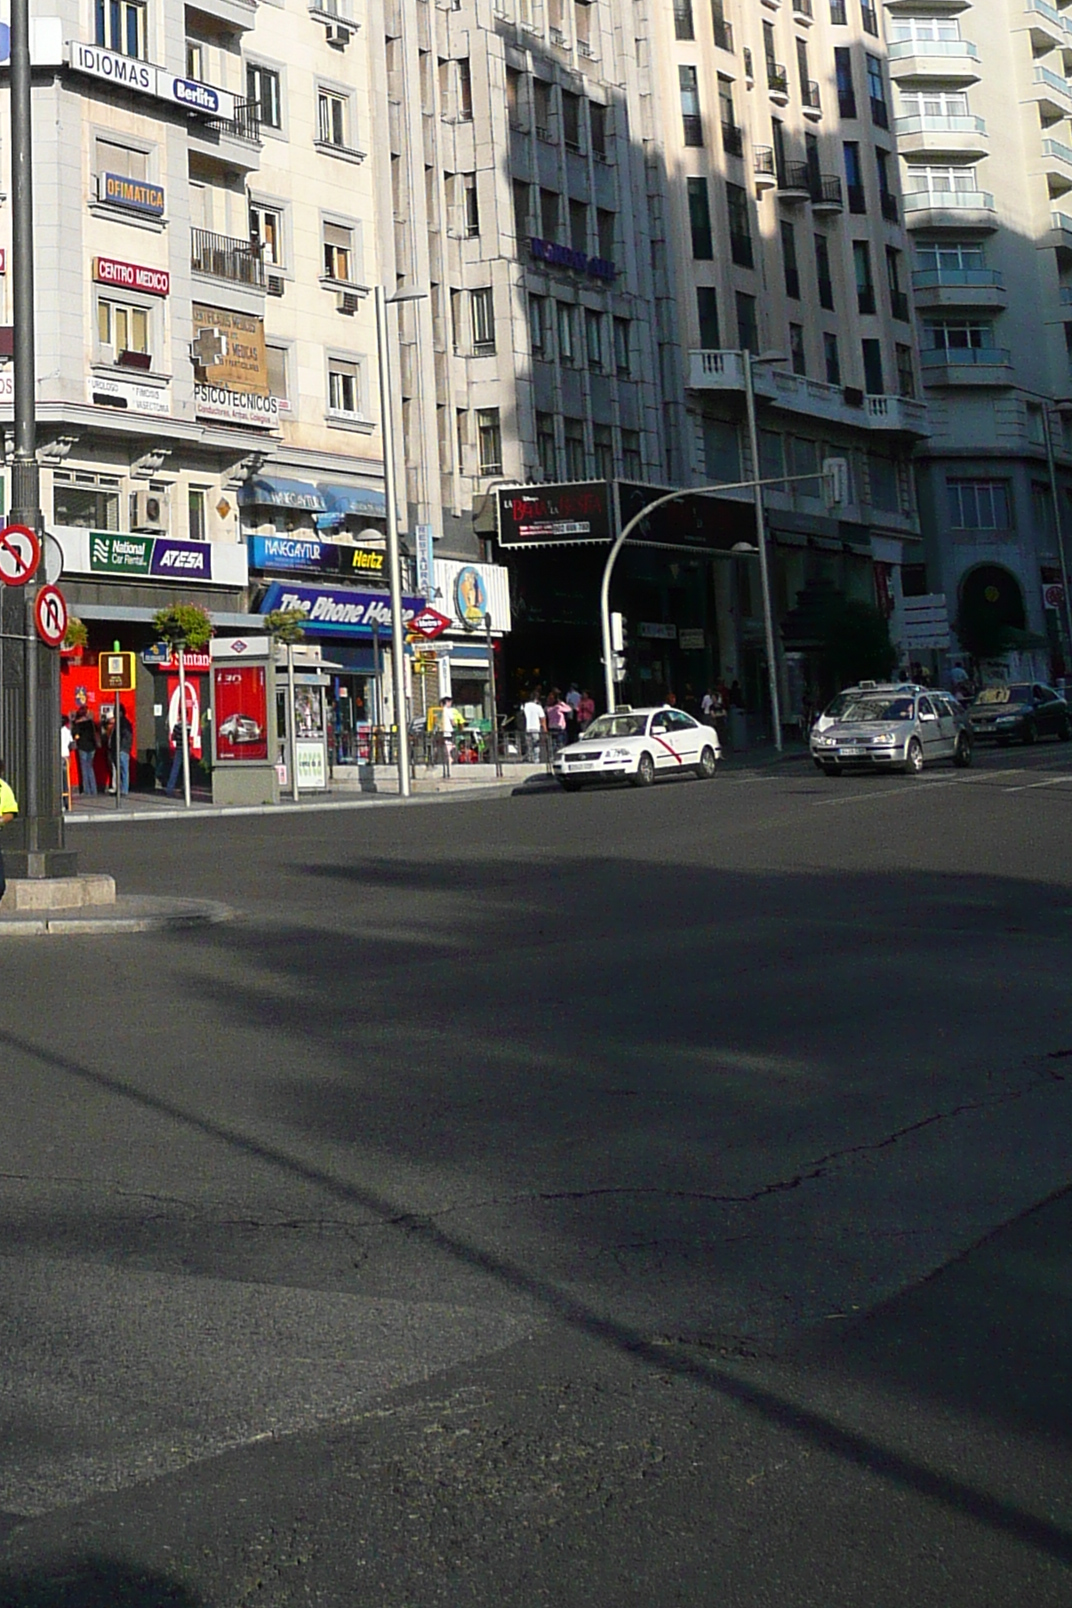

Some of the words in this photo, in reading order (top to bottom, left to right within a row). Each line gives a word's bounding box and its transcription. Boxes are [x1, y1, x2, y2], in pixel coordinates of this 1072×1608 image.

[79, 47, 149, 87] IDIOMAS
[176, 81, 216, 108] Berlitz
[107, 178, 163, 207] OFIMATICA
[99, 261, 133, 284] CENTRO
[136, 269, 168, 291] MEDICO
[194, 386, 278, 414] PSICOTECNICOS
[112, 540, 146, 555] National
[160, 550, 204, 569] ATESA
[264, 539, 322, 560] NAVEGAYTUR
[352, 549, 383, 569] Hertz
[280, 593, 311, 612] The
[310, 597, 364, 623] Phone
